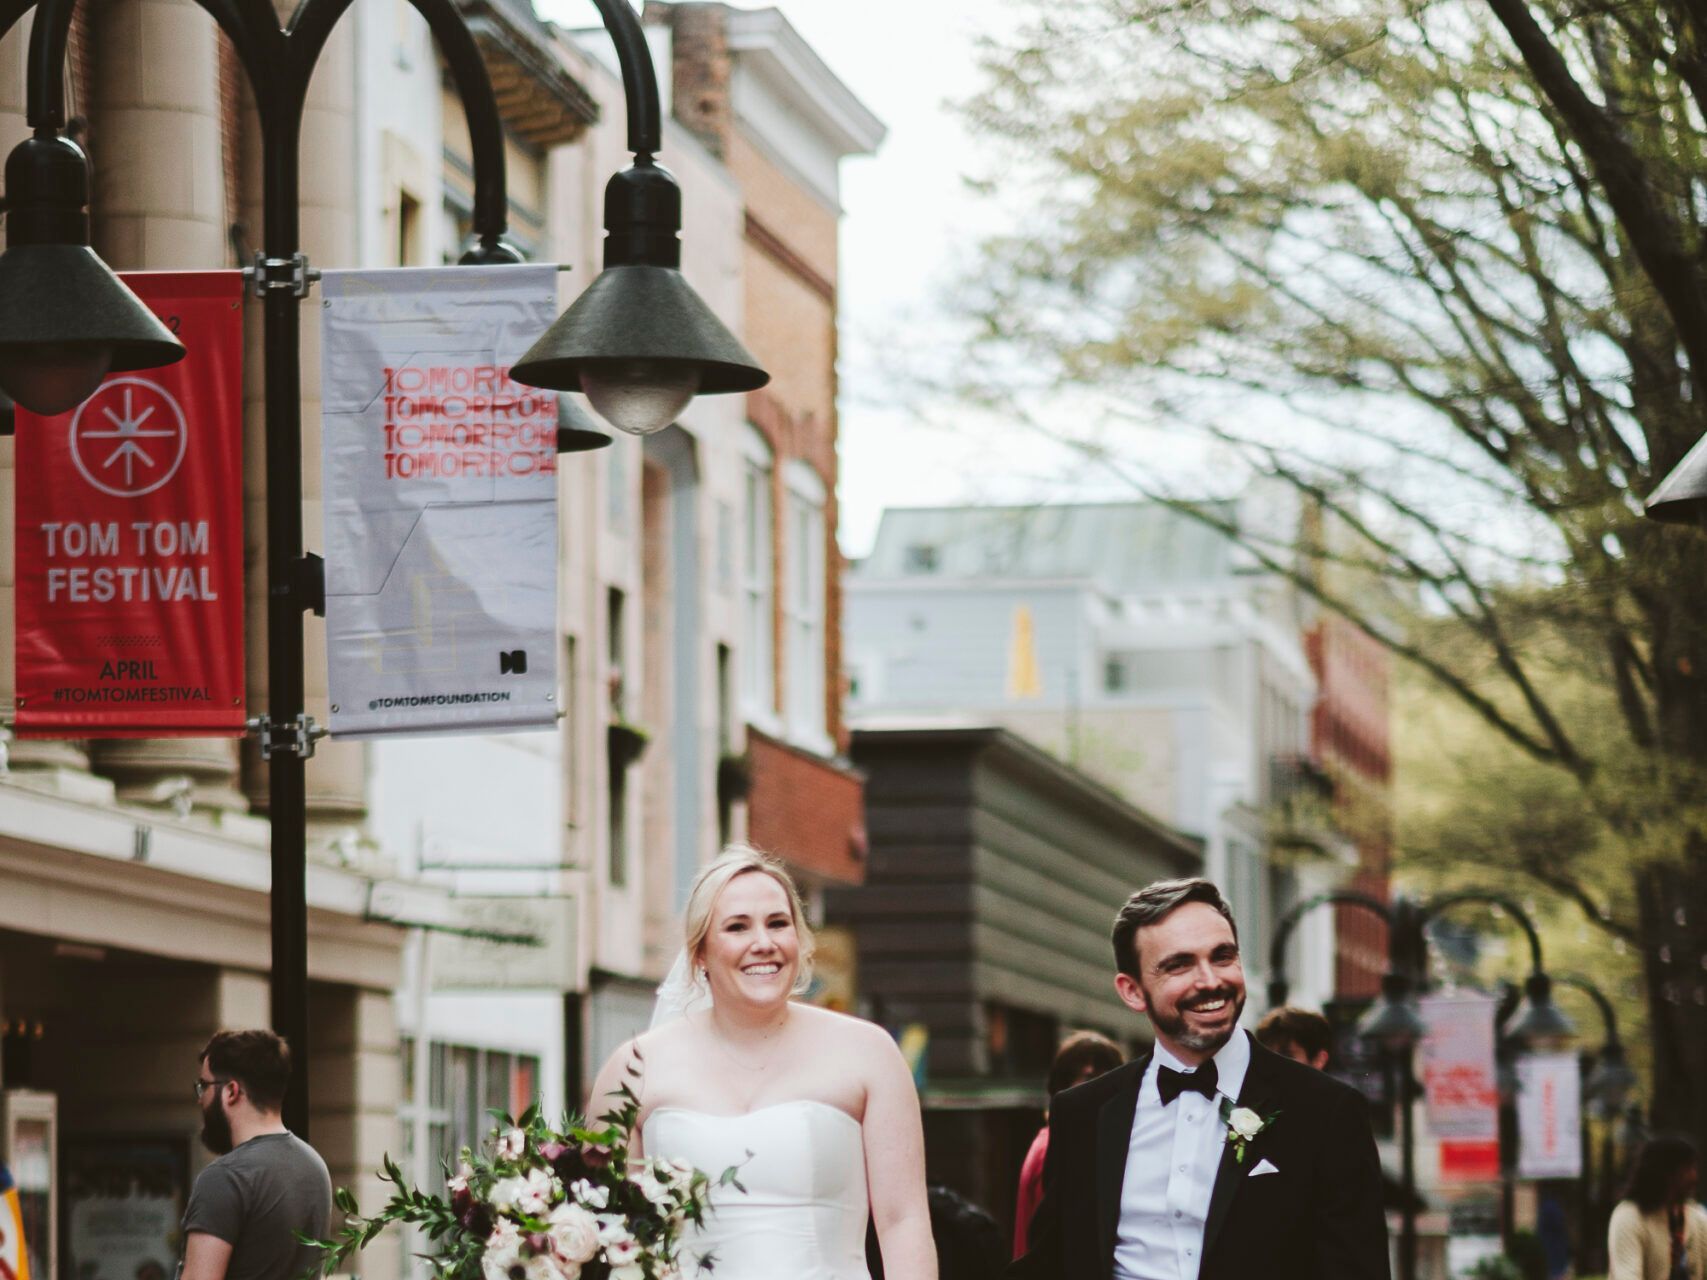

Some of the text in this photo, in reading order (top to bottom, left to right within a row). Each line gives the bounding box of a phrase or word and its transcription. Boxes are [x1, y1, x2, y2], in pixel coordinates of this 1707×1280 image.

[41, 521, 209, 557] TOM TOM
[48, 566, 218, 602] FESTIVAL
[100, 660, 158, 680] APRIL
[54, 687, 212, 703] #TOMTOMFESTIVAL
[368, 691, 511, 710] @TOMTOMFOUNDATION
